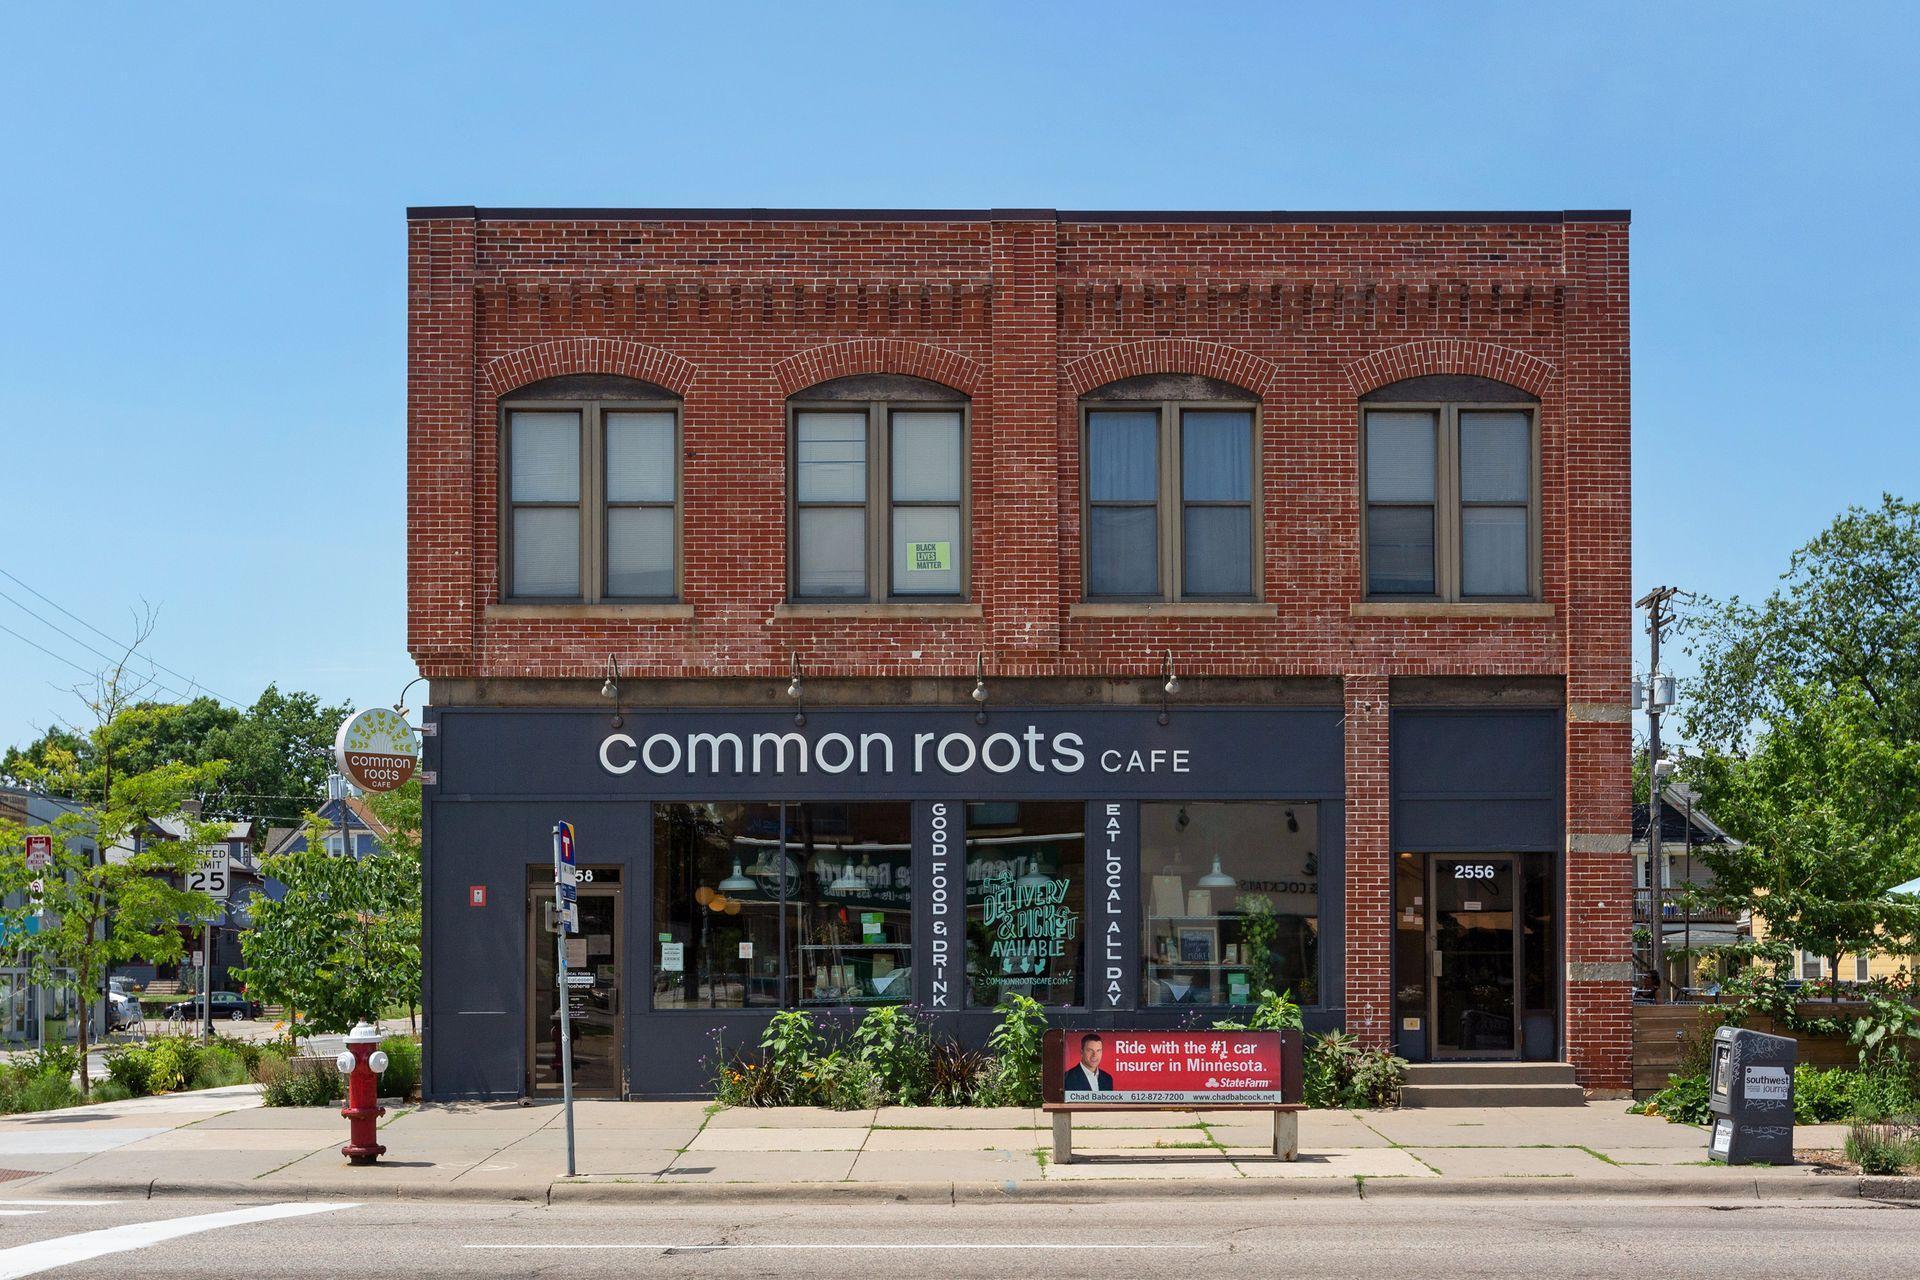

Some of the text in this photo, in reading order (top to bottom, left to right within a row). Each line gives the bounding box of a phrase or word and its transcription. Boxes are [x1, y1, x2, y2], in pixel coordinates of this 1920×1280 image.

[915, 543, 936, 551] BLACK
[917, 552, 936, 561] LIVES
[916, 561, 942, 569] MATTER
[600, 725, 1191, 774] common roots CAFE
[351, 755, 411, 769] common
[364, 768, 400, 780] roots
[931, 803, 947, 856] GOOD
[190, 849, 226, 859] PEED
[1454, 864, 1495, 879] 2556
[190, 872, 226, 891] 25
[932, 862, 948, 915] FOOD
[983, 878, 1070, 927] DELIVERY
[1106, 804, 1122, 1006] EAT LOCAL ALL DAY
[990, 939, 1065, 957] AVAILABLE
[932, 940, 948, 1007] DRINK
[1115, 1041, 1258, 1054] Ride with the #1 car
[1115, 1059, 1267, 1072] insurer in Minnesota.
[1746, 1075, 1790, 1085] southwest
[1762, 1085, 1788, 1093] journa
[1193, 1093, 1275, 1101] www.chadbabcock.net
